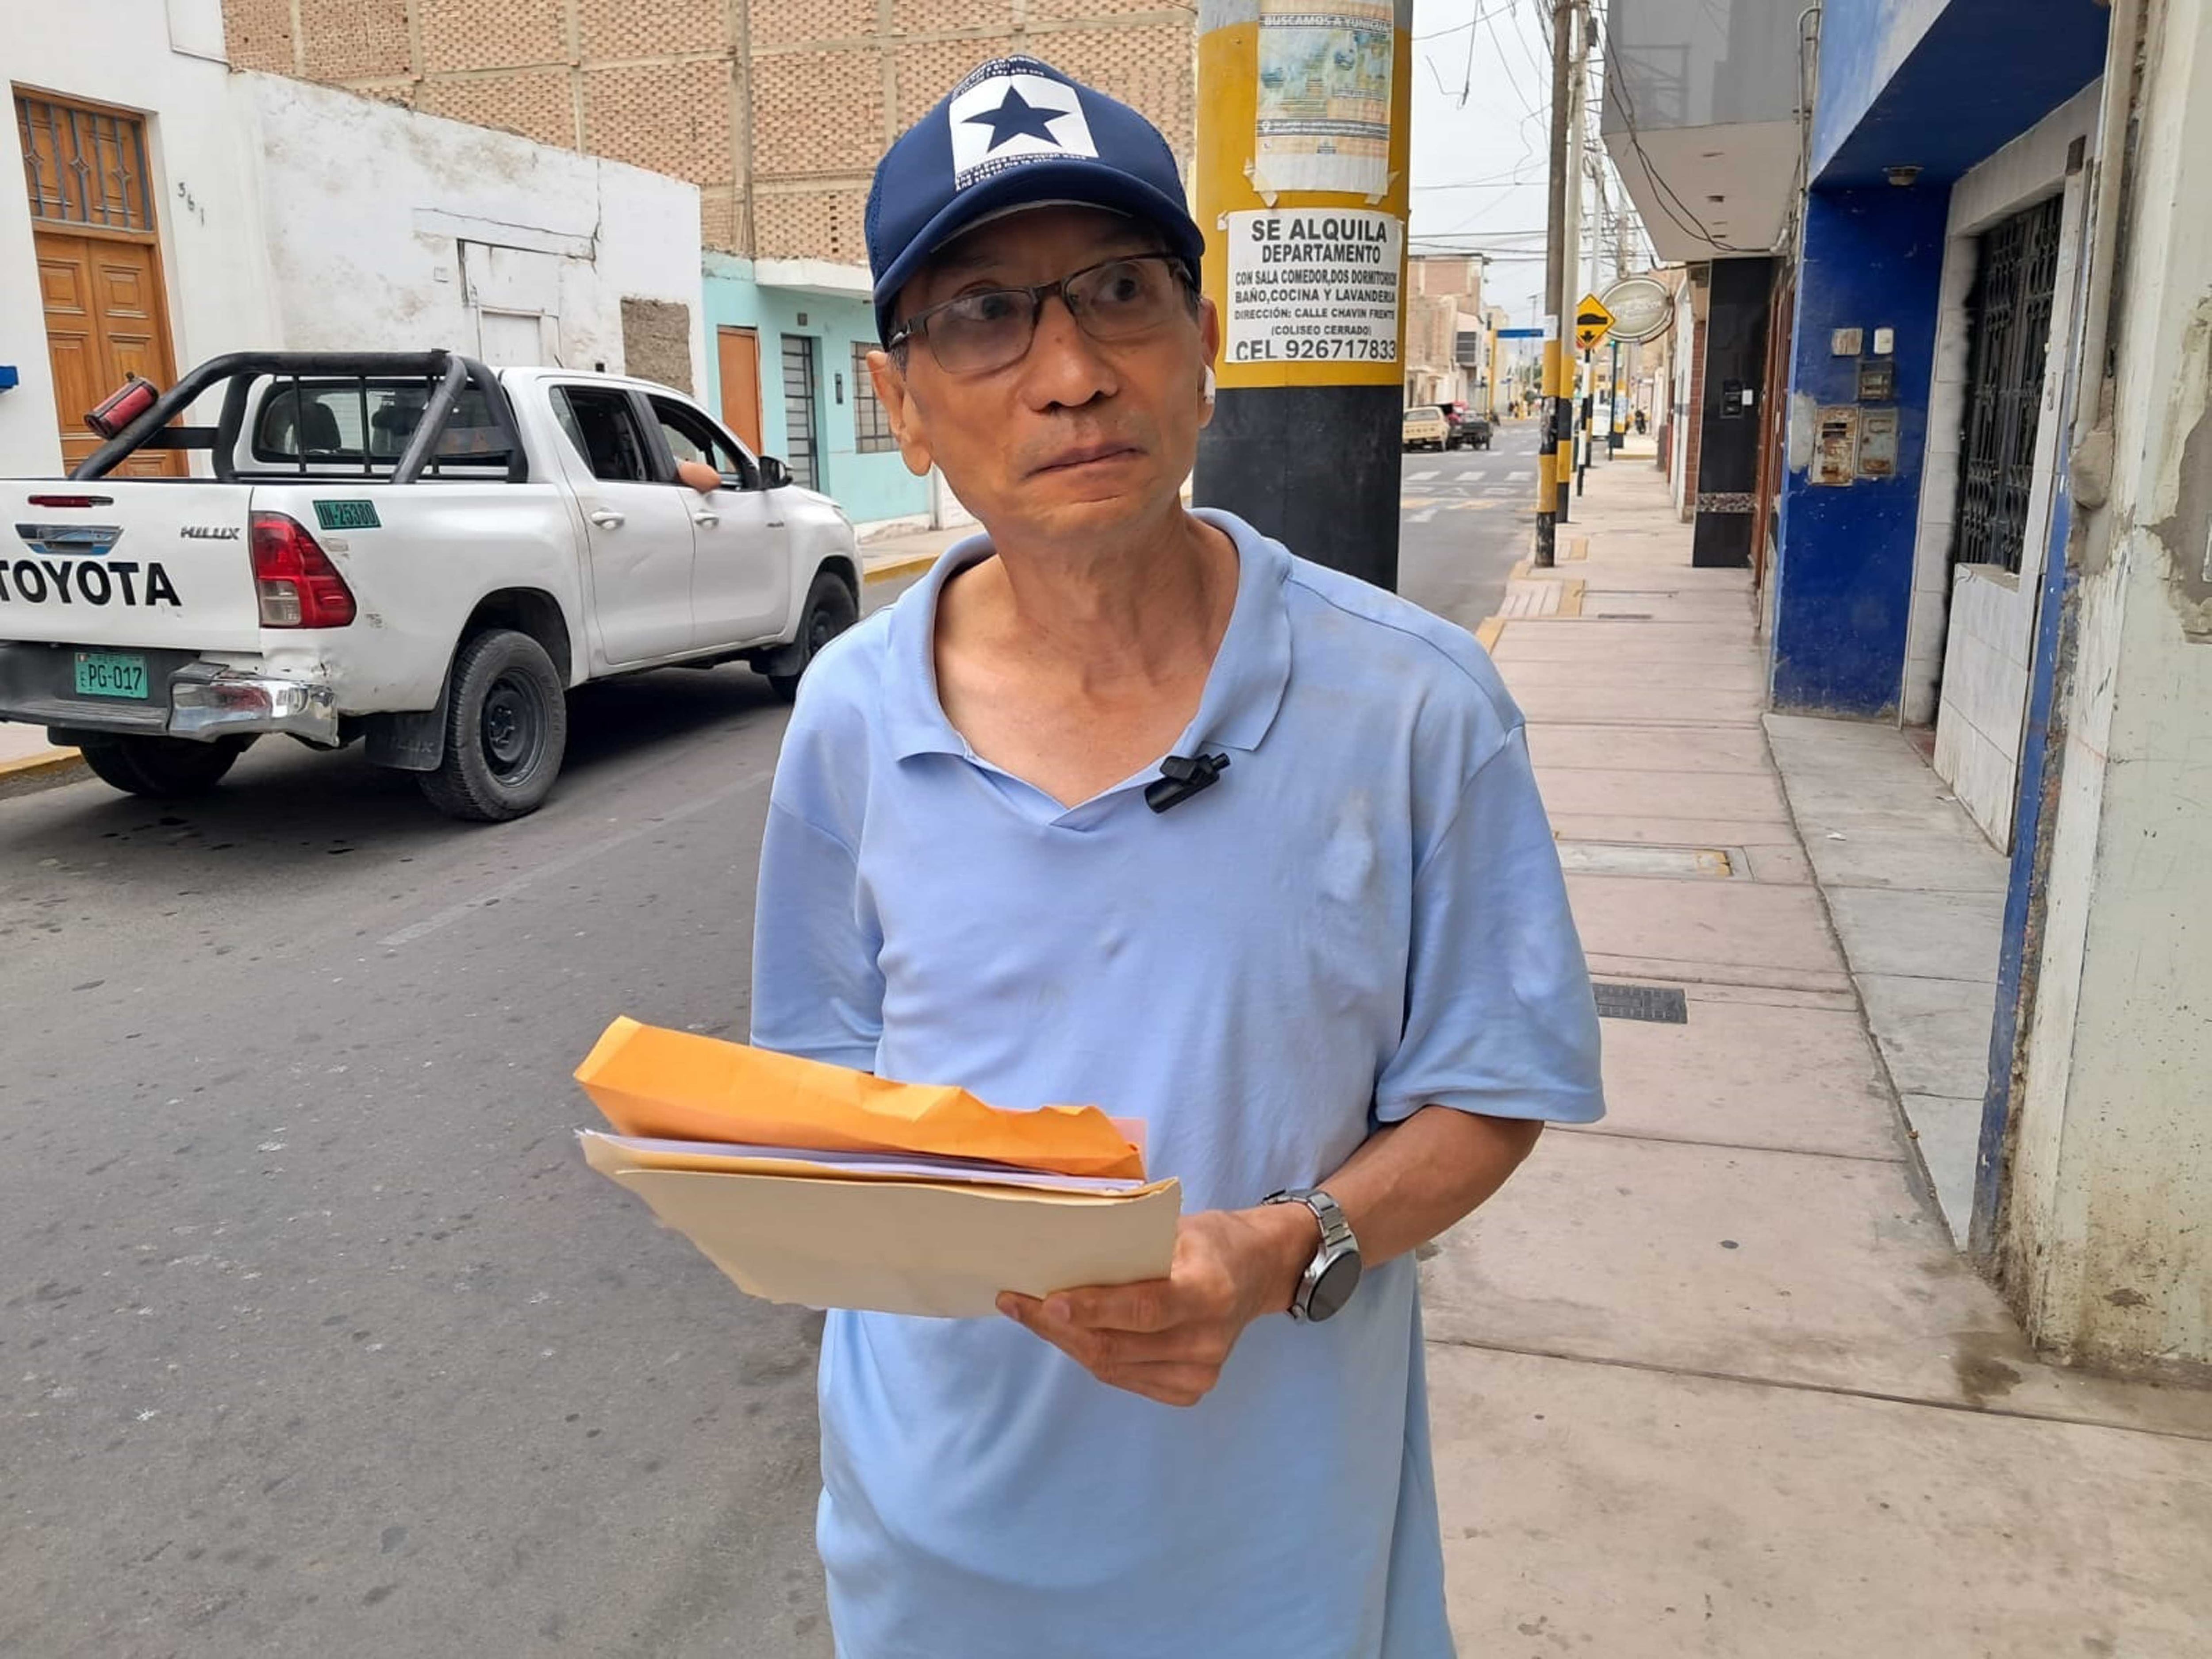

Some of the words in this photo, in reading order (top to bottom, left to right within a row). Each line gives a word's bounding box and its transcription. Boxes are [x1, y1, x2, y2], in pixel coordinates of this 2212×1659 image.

[1252, 219, 1281, 242] SE
[1289, 219, 1387, 243] ALQUILA
[1262, 244, 1381, 264] DEPARTAMENTO
[1236, 271, 1253, 285] CON
[1255, 269, 1279, 284] SALA
[1323, 288, 1332, 301] Y
[1234, 306, 1291, 320] DIRECCIÓN:
[1294, 307, 1328, 319] CALLE
[1331, 307, 1367, 319] CHAVIN
[1369, 308, 1395, 320] FRENTE
[1271, 325, 1321, 336] (COLISEO
[1323, 325, 1372, 336] CERRADO)
[1236, 339, 1278, 361] CEL
[1285, 339, 1396, 360] 926717833
[180, 526, 240, 540] HILUX
[88, 663, 142, 690] PG-017
